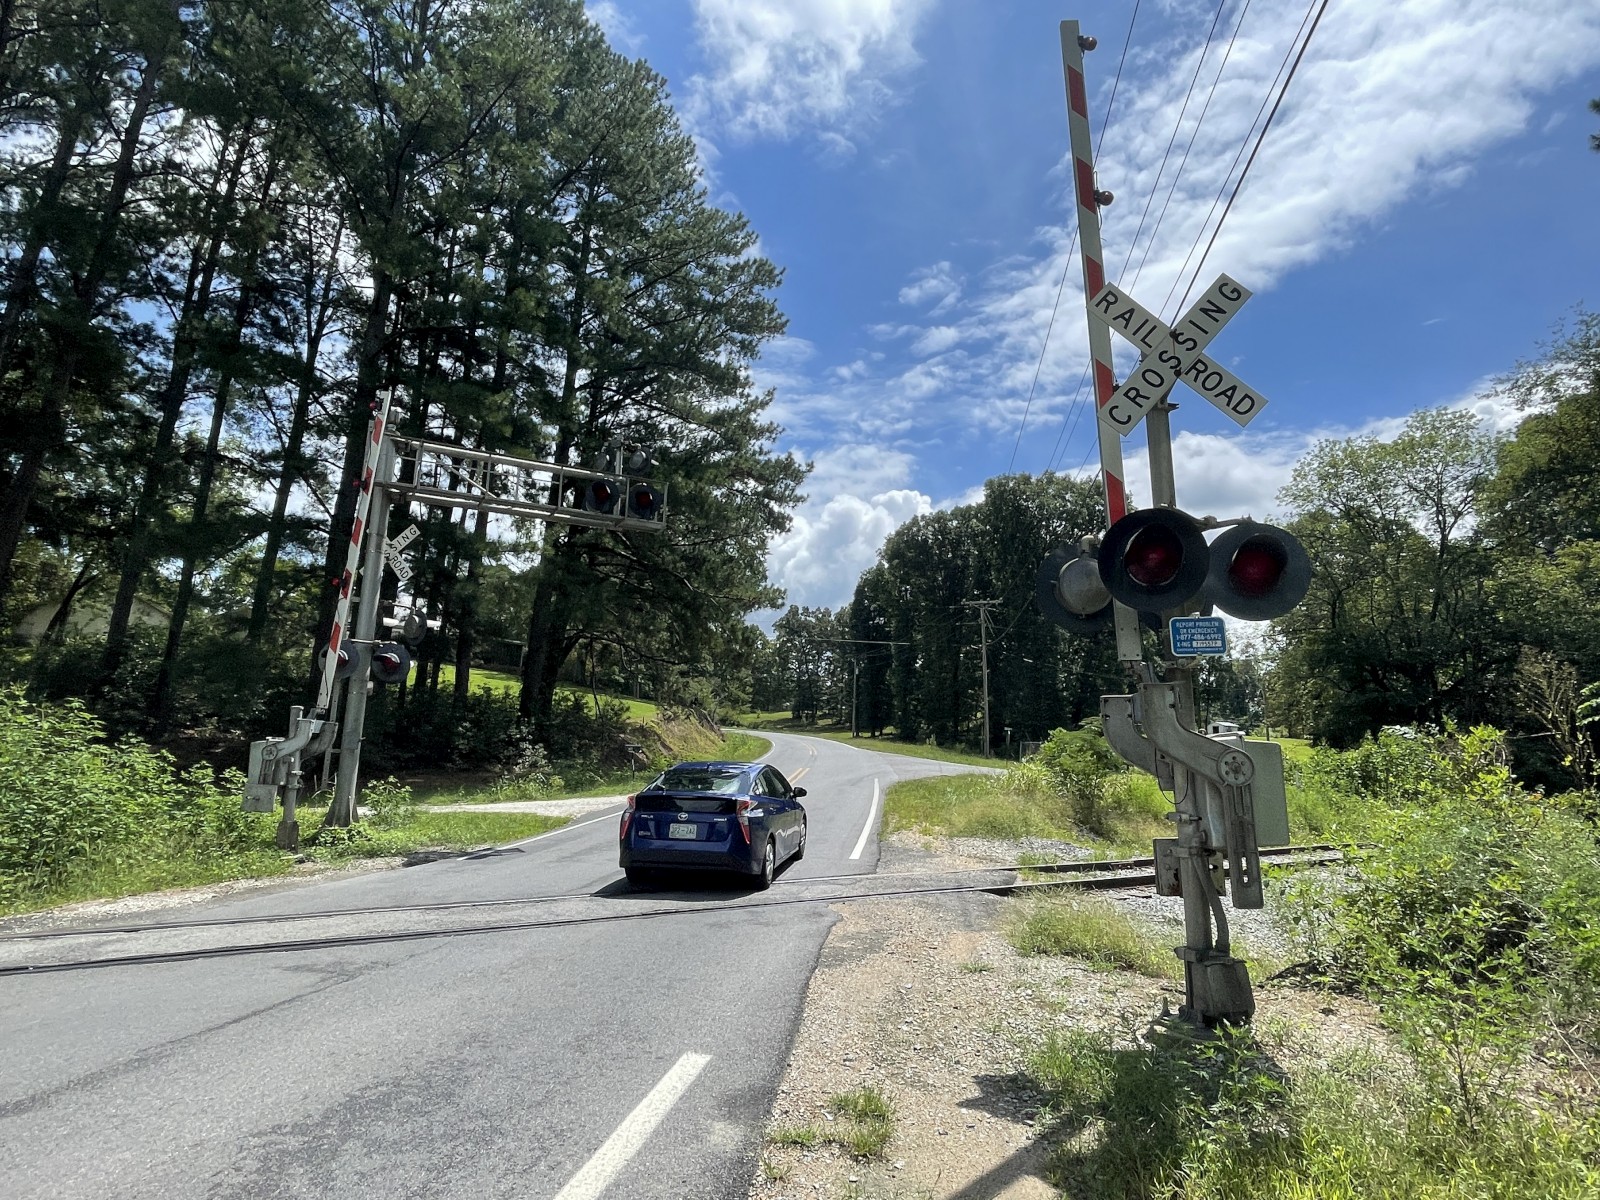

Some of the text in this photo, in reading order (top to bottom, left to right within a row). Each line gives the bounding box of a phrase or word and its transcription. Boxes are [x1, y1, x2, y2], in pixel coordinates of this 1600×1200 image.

[1094, 290, 1256, 416] RAIL ROAD
[1108, 282, 1242, 426] CROSSING
[384, 527, 417, 559] SSING
[391, 555, 409, 579] ROAD
